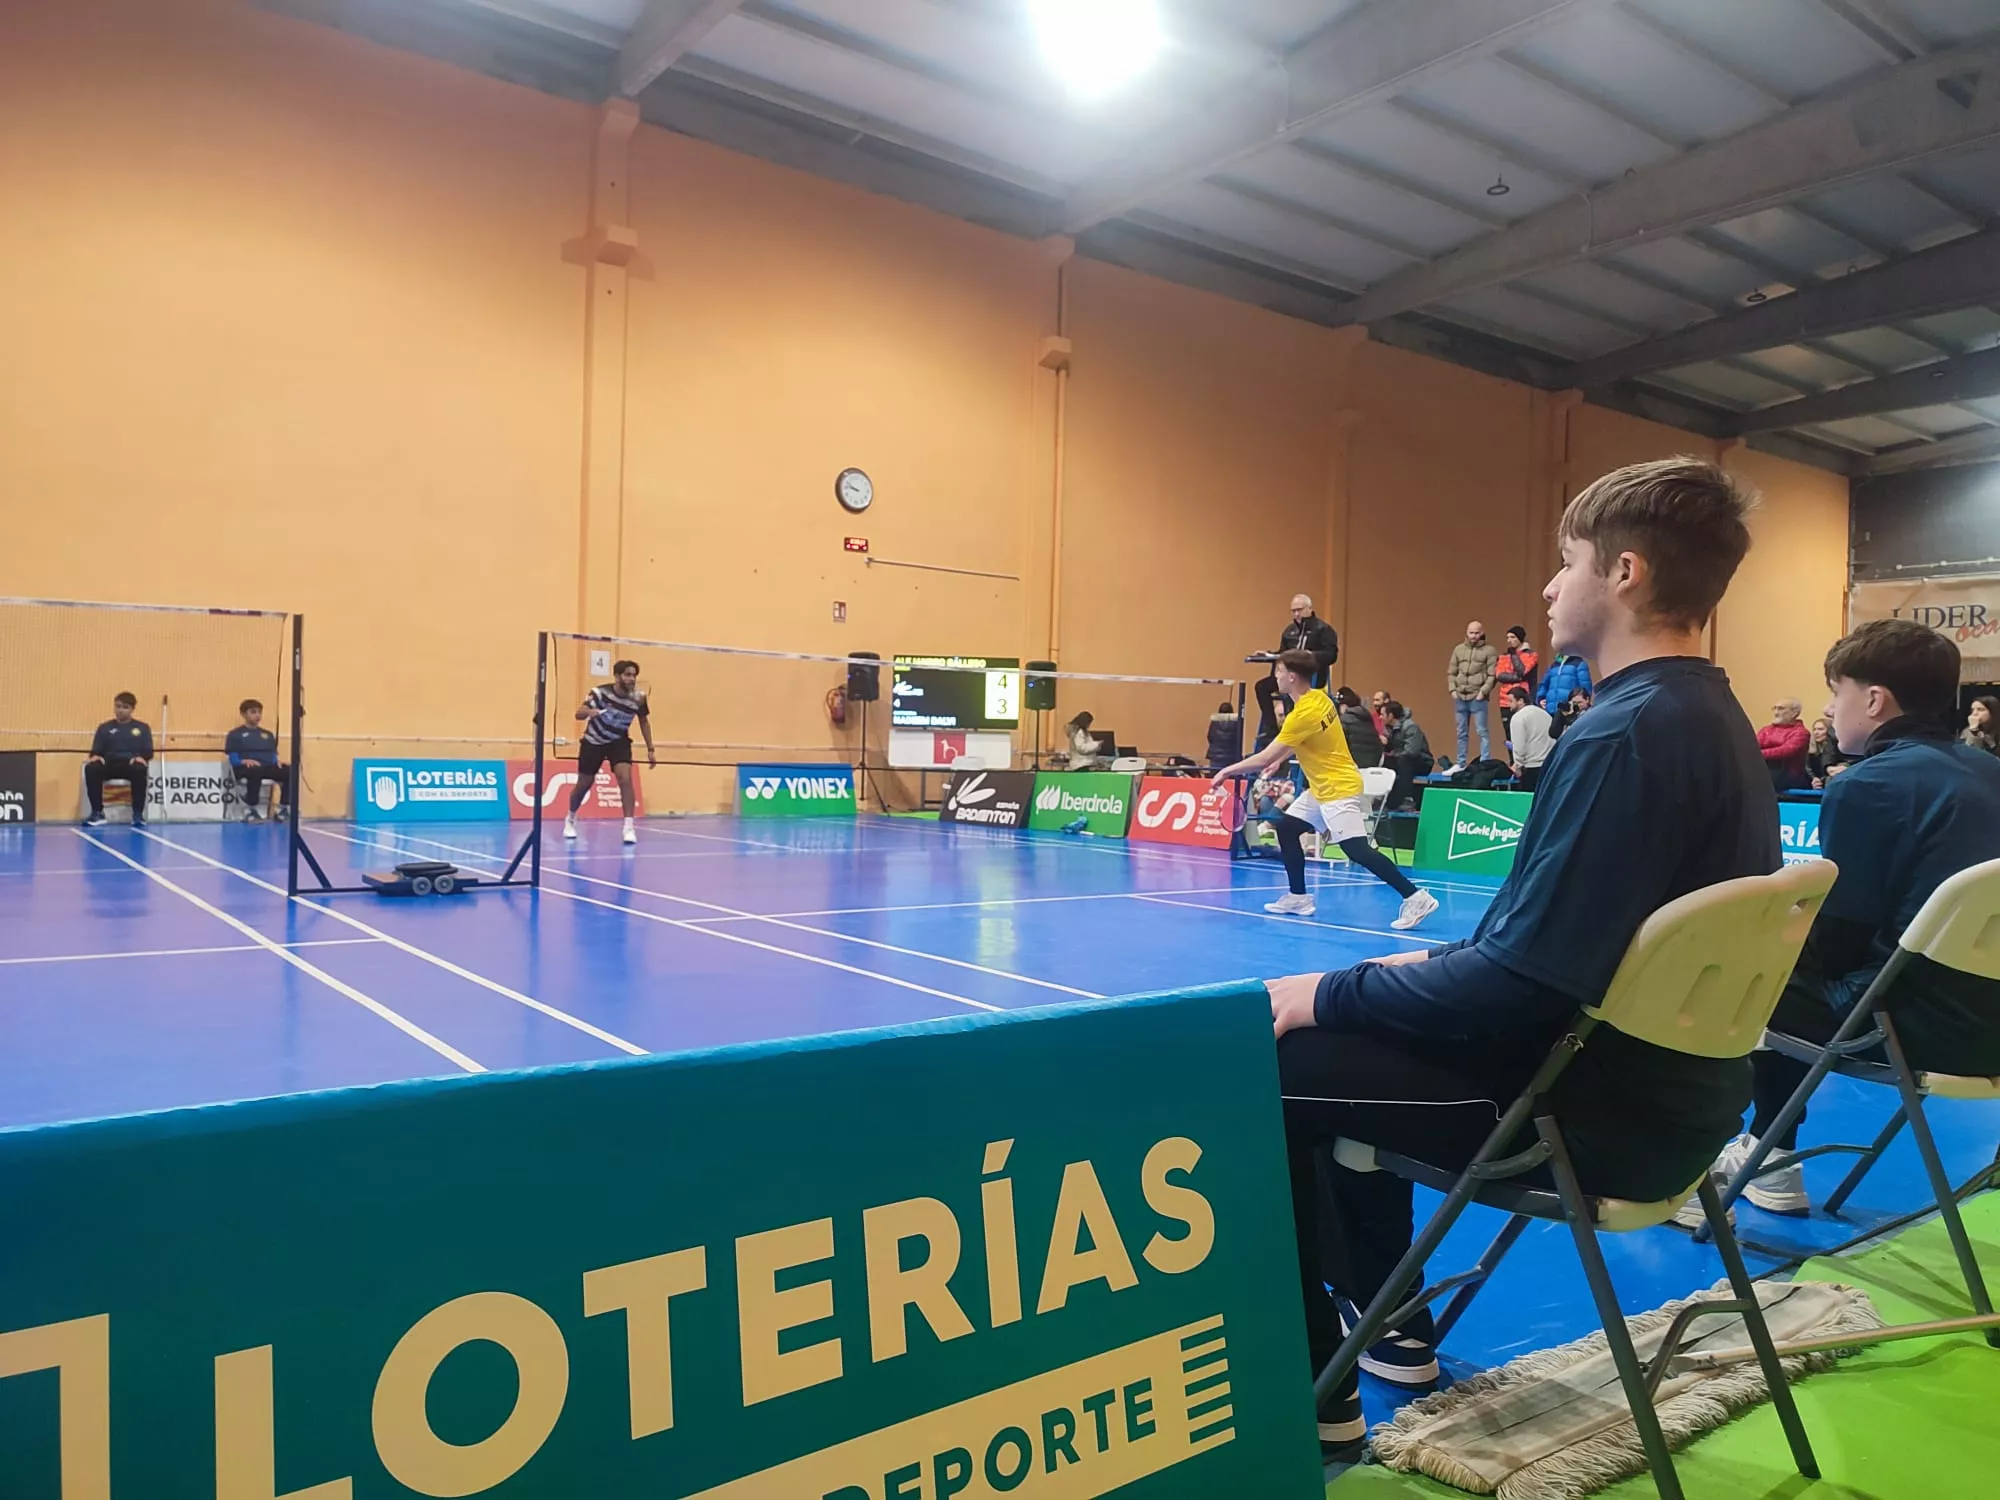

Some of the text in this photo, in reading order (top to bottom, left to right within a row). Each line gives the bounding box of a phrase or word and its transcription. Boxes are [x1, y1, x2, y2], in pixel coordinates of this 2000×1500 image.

[596, 657, 604, 668] 4
[997, 674, 1008, 689] 4
[996, 698, 1008, 715] 3
[407, 768, 498, 786] LOTERÍAS
[784, 776, 851, 800] YONEX
[1061, 790, 1123, 815] Iberdrola
[215, 1136, 1216, 1500] LOTERÍAS
[822, 1376, 1157, 1500] EPORTE
